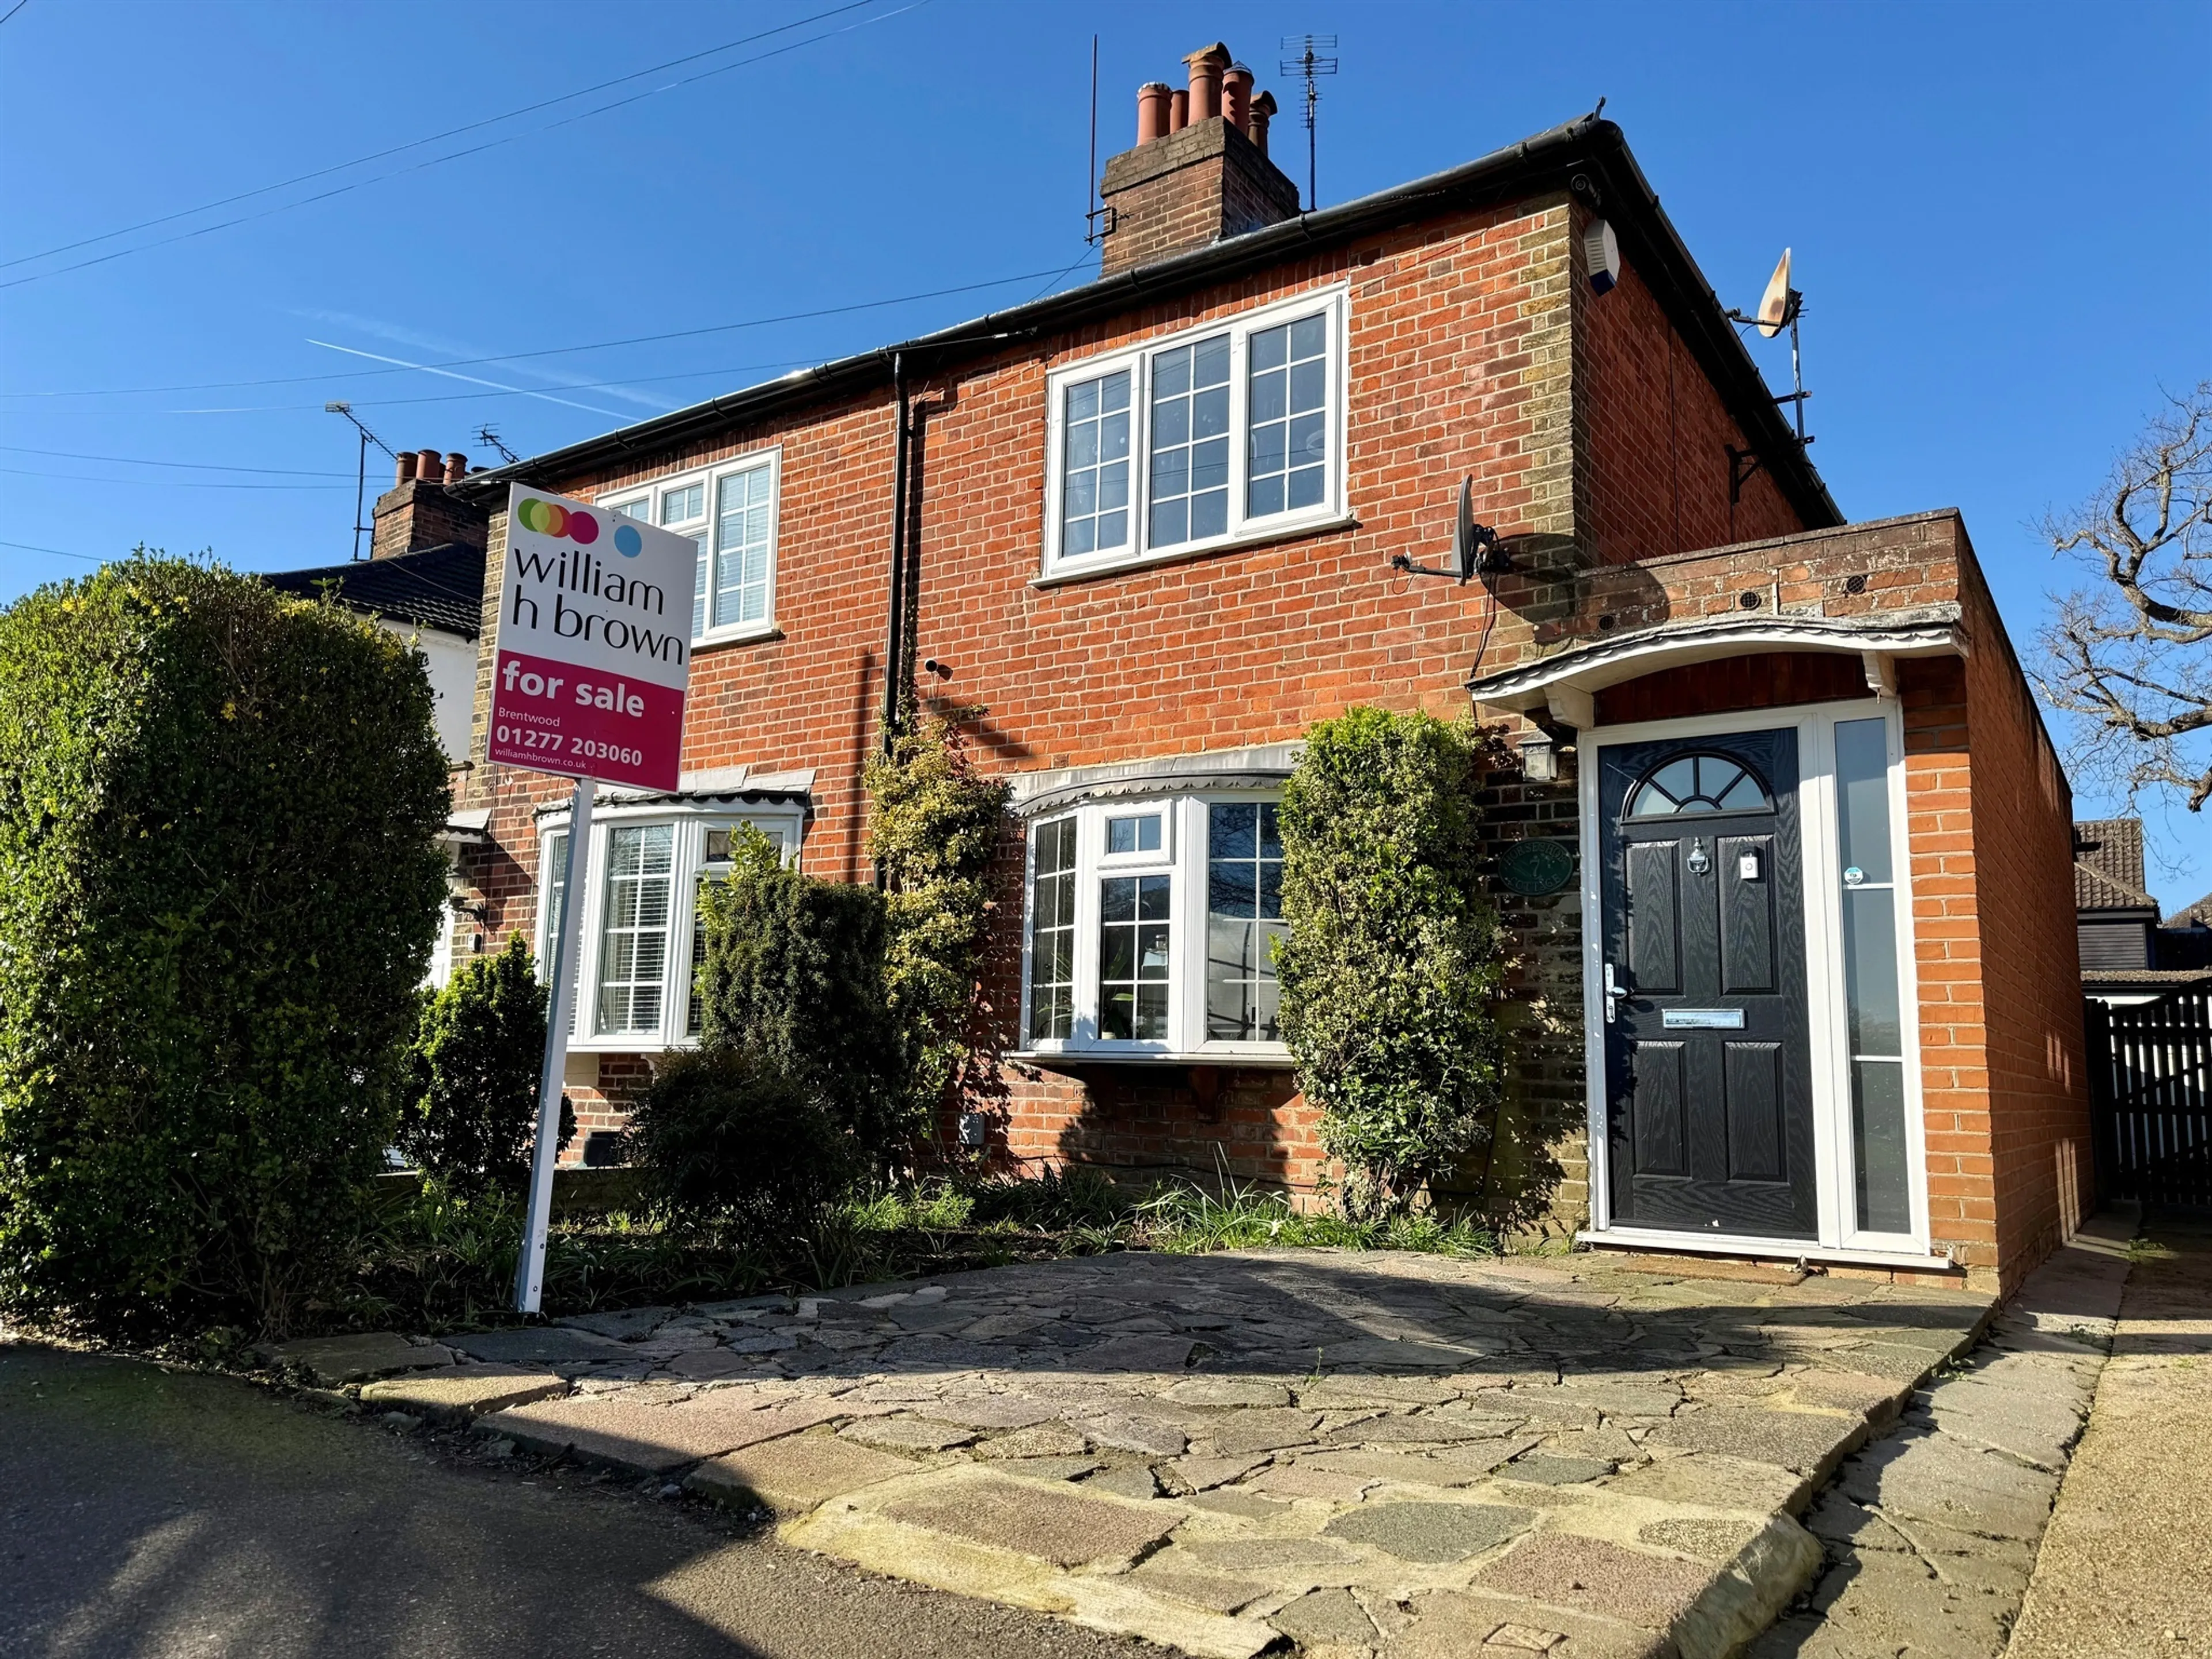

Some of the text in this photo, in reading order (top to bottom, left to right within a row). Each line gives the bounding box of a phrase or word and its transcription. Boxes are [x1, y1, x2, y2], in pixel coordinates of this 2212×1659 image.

[515, 548, 664, 615] william
[513, 585, 683, 665] h brown
[503, 661, 645, 717] for sale
[499, 707, 560, 727] Brentwood
[495, 749, 586, 769] williamhbrown.co.uk
[497, 725, 642, 766] 01277 203060
[1508, 874, 1561, 892] COTTAGE
